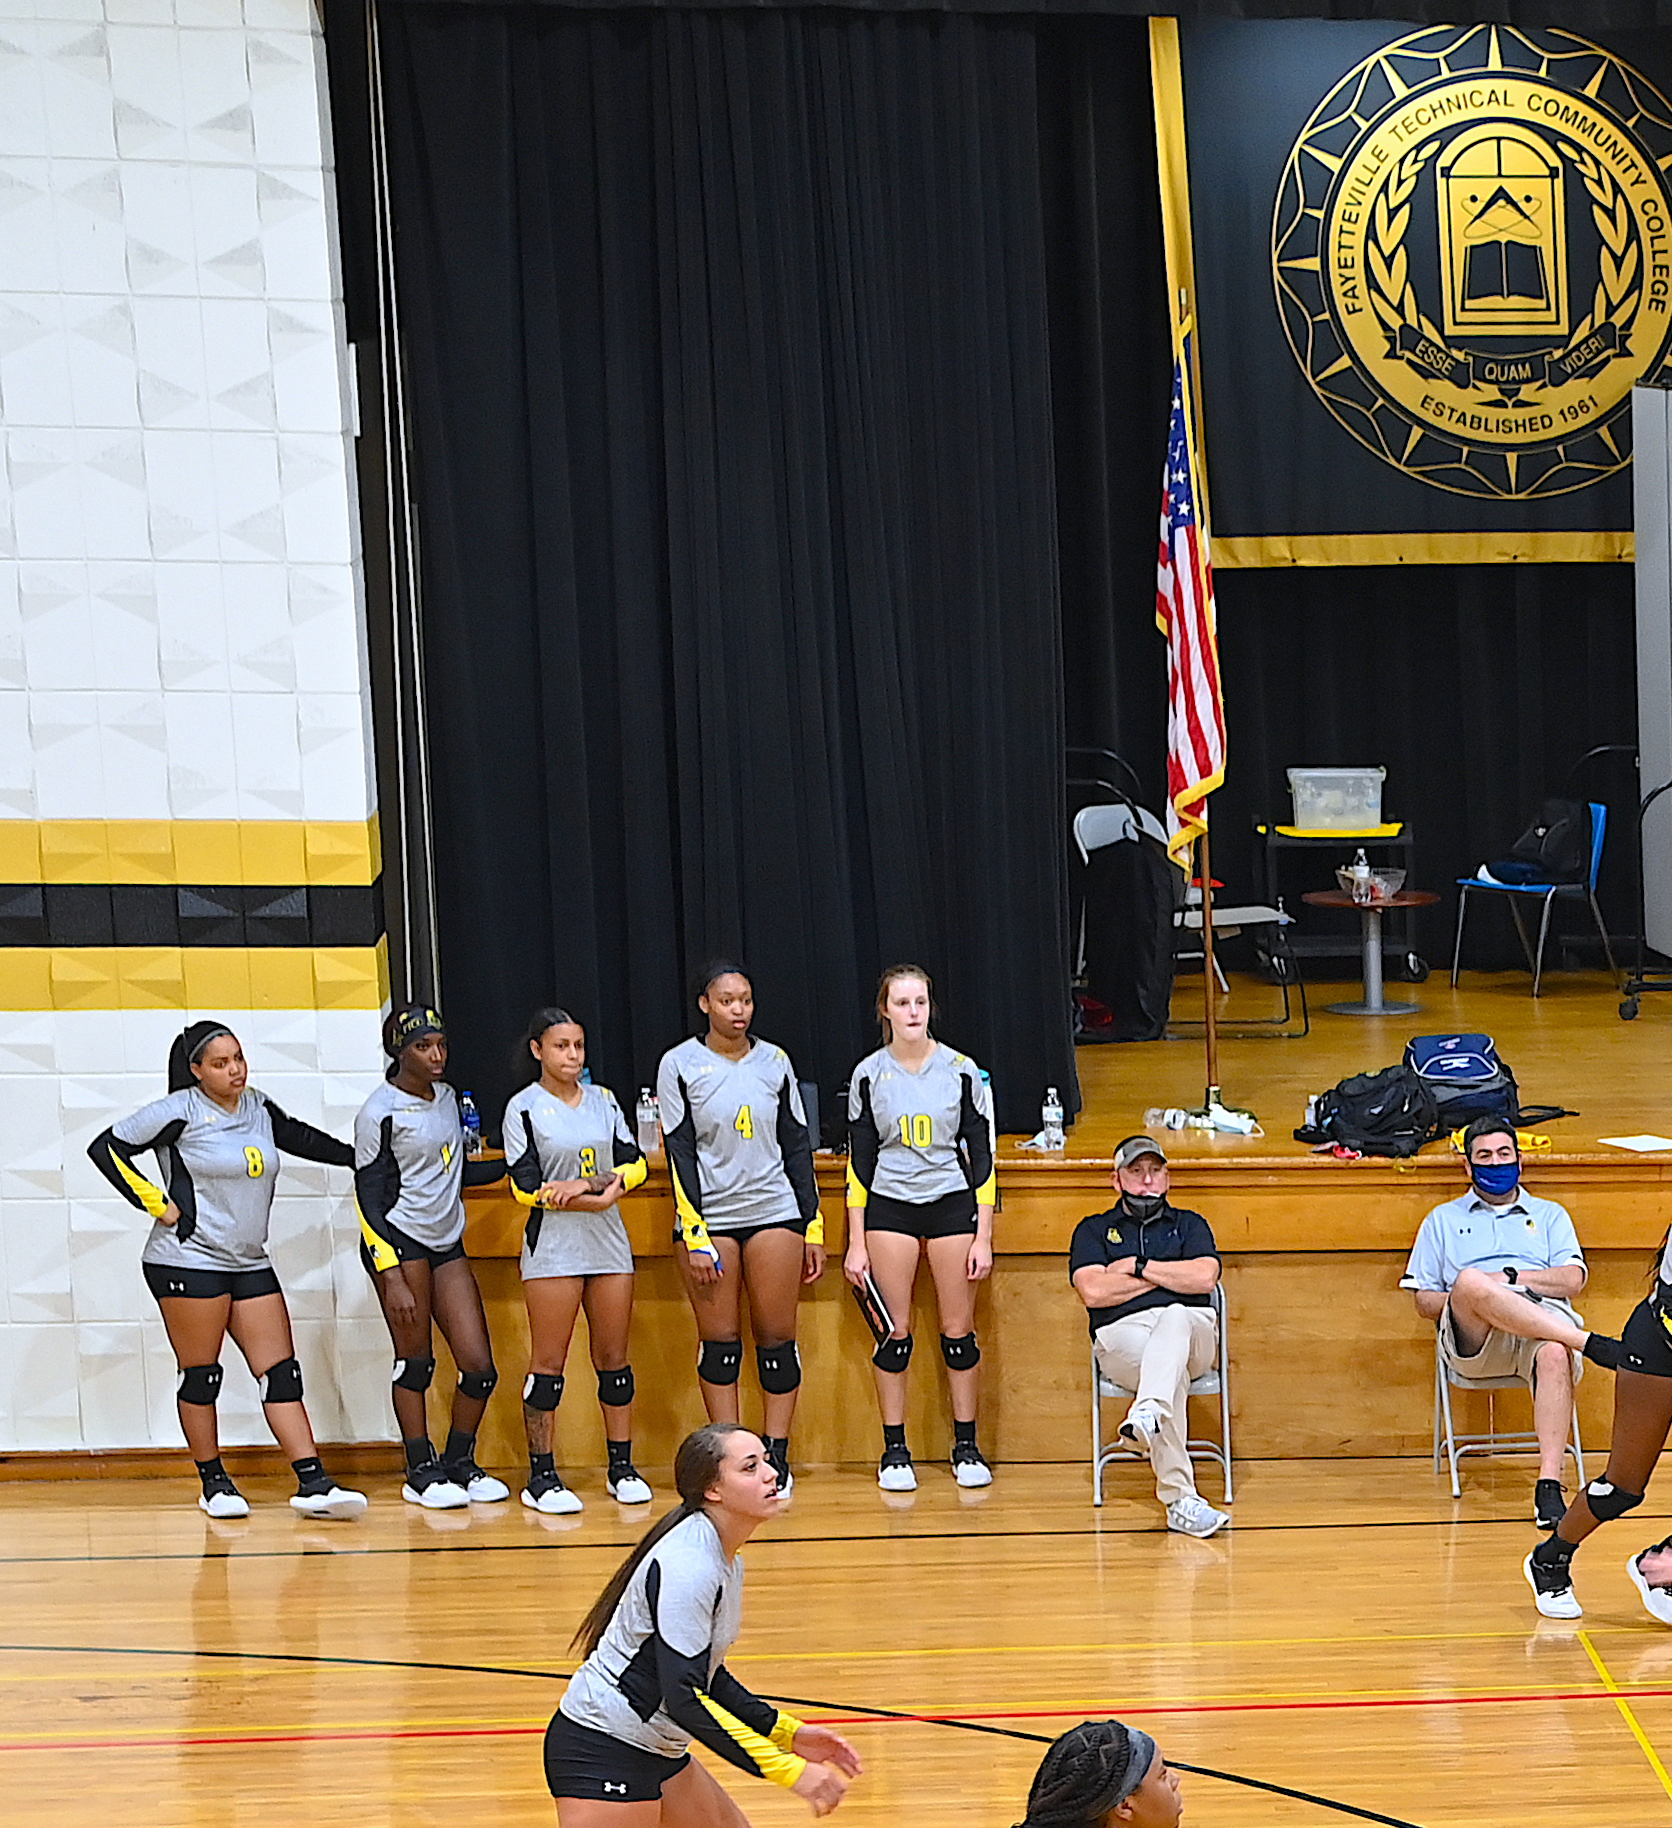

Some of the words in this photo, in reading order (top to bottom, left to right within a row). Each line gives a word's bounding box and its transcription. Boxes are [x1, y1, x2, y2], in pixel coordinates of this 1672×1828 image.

[1337, 143, 1390, 315] FAYETTEVILLE
[1389, 89, 1516, 143] TECHNICAL
[1527, 92, 1648, 187] COMMUNITY
[1640, 197, 1671, 312] COLLEGE
[1414, 339, 1455, 376] ESSE
[1484, 362, 1532, 381] QUAM
[1559, 335, 1605, 375] VIDERI
[1420, 395, 1554, 434] ESTABLISHED
[1557, 394, 1599, 423] 1961
[734, 1105, 753, 1139] 4
[898, 1114, 931, 1148] 10
[244, 1146, 264, 1179] 8
[580, 1147, 597, 1178] 2
